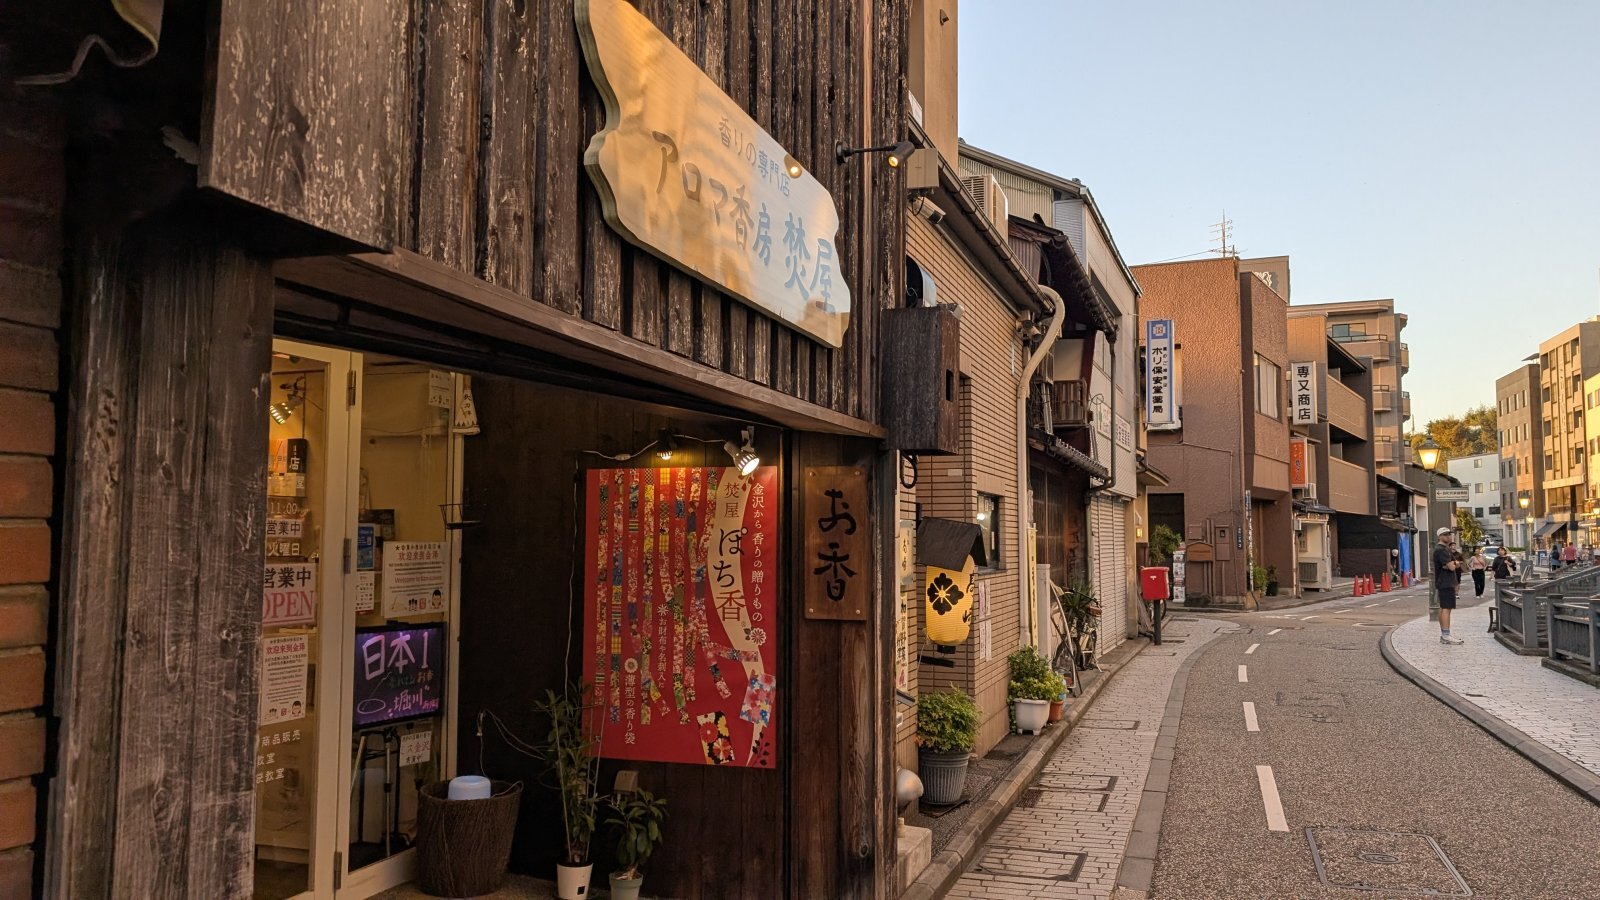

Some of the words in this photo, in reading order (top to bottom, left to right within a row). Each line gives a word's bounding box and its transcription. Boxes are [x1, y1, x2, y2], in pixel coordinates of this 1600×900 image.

[718, 115, 790, 197] 香りの専門店
[651, 130, 772, 267] アロマ香房
[1152, 346, 1164, 414] ホリ保安堂薬局
[1297, 365, 1311, 420] 専又商店
[267, 520, 301, 535] 営業中
[724, 482, 740, 518] 焚屋
[264, 567, 312, 589] 営業中
[268, 542, 300, 556] 火曜日
[713, 527, 749, 622] ぽち香
[751, 482, 765, 622] 金沢から香りの贈りもの
[813, 488, 858, 602] お香
[261, 729, 301, 747] 商品販売
[624, 674, 636, 745] 薄型の香り袋
